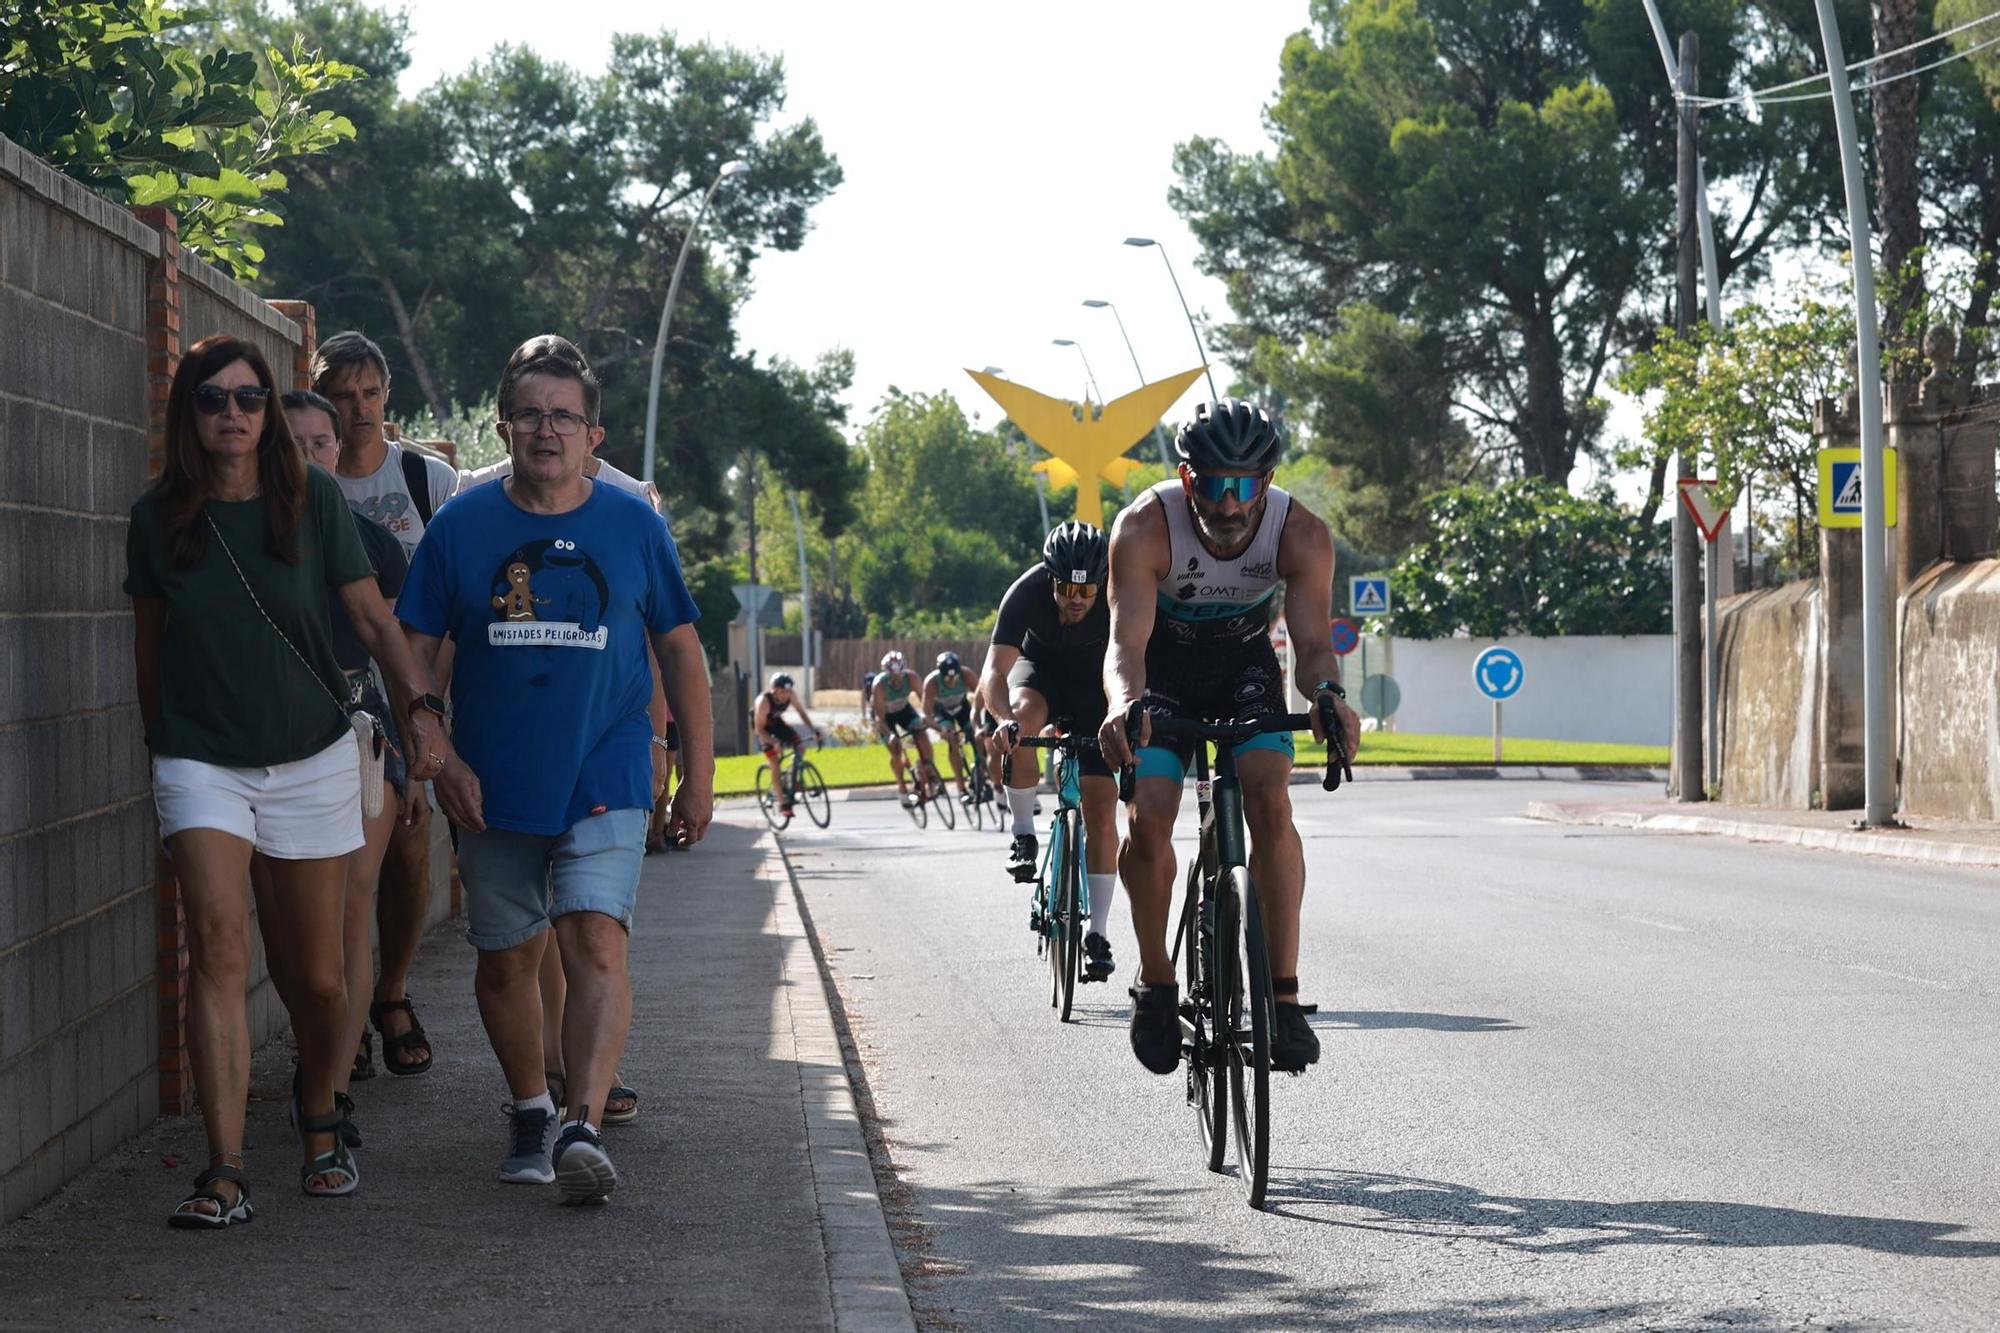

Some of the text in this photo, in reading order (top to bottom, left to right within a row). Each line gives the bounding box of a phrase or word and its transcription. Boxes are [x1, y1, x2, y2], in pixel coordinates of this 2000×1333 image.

[1200, 586, 1240, 596] OMT
[493, 629, 602, 642] AMISTADES PELIGROSAS
